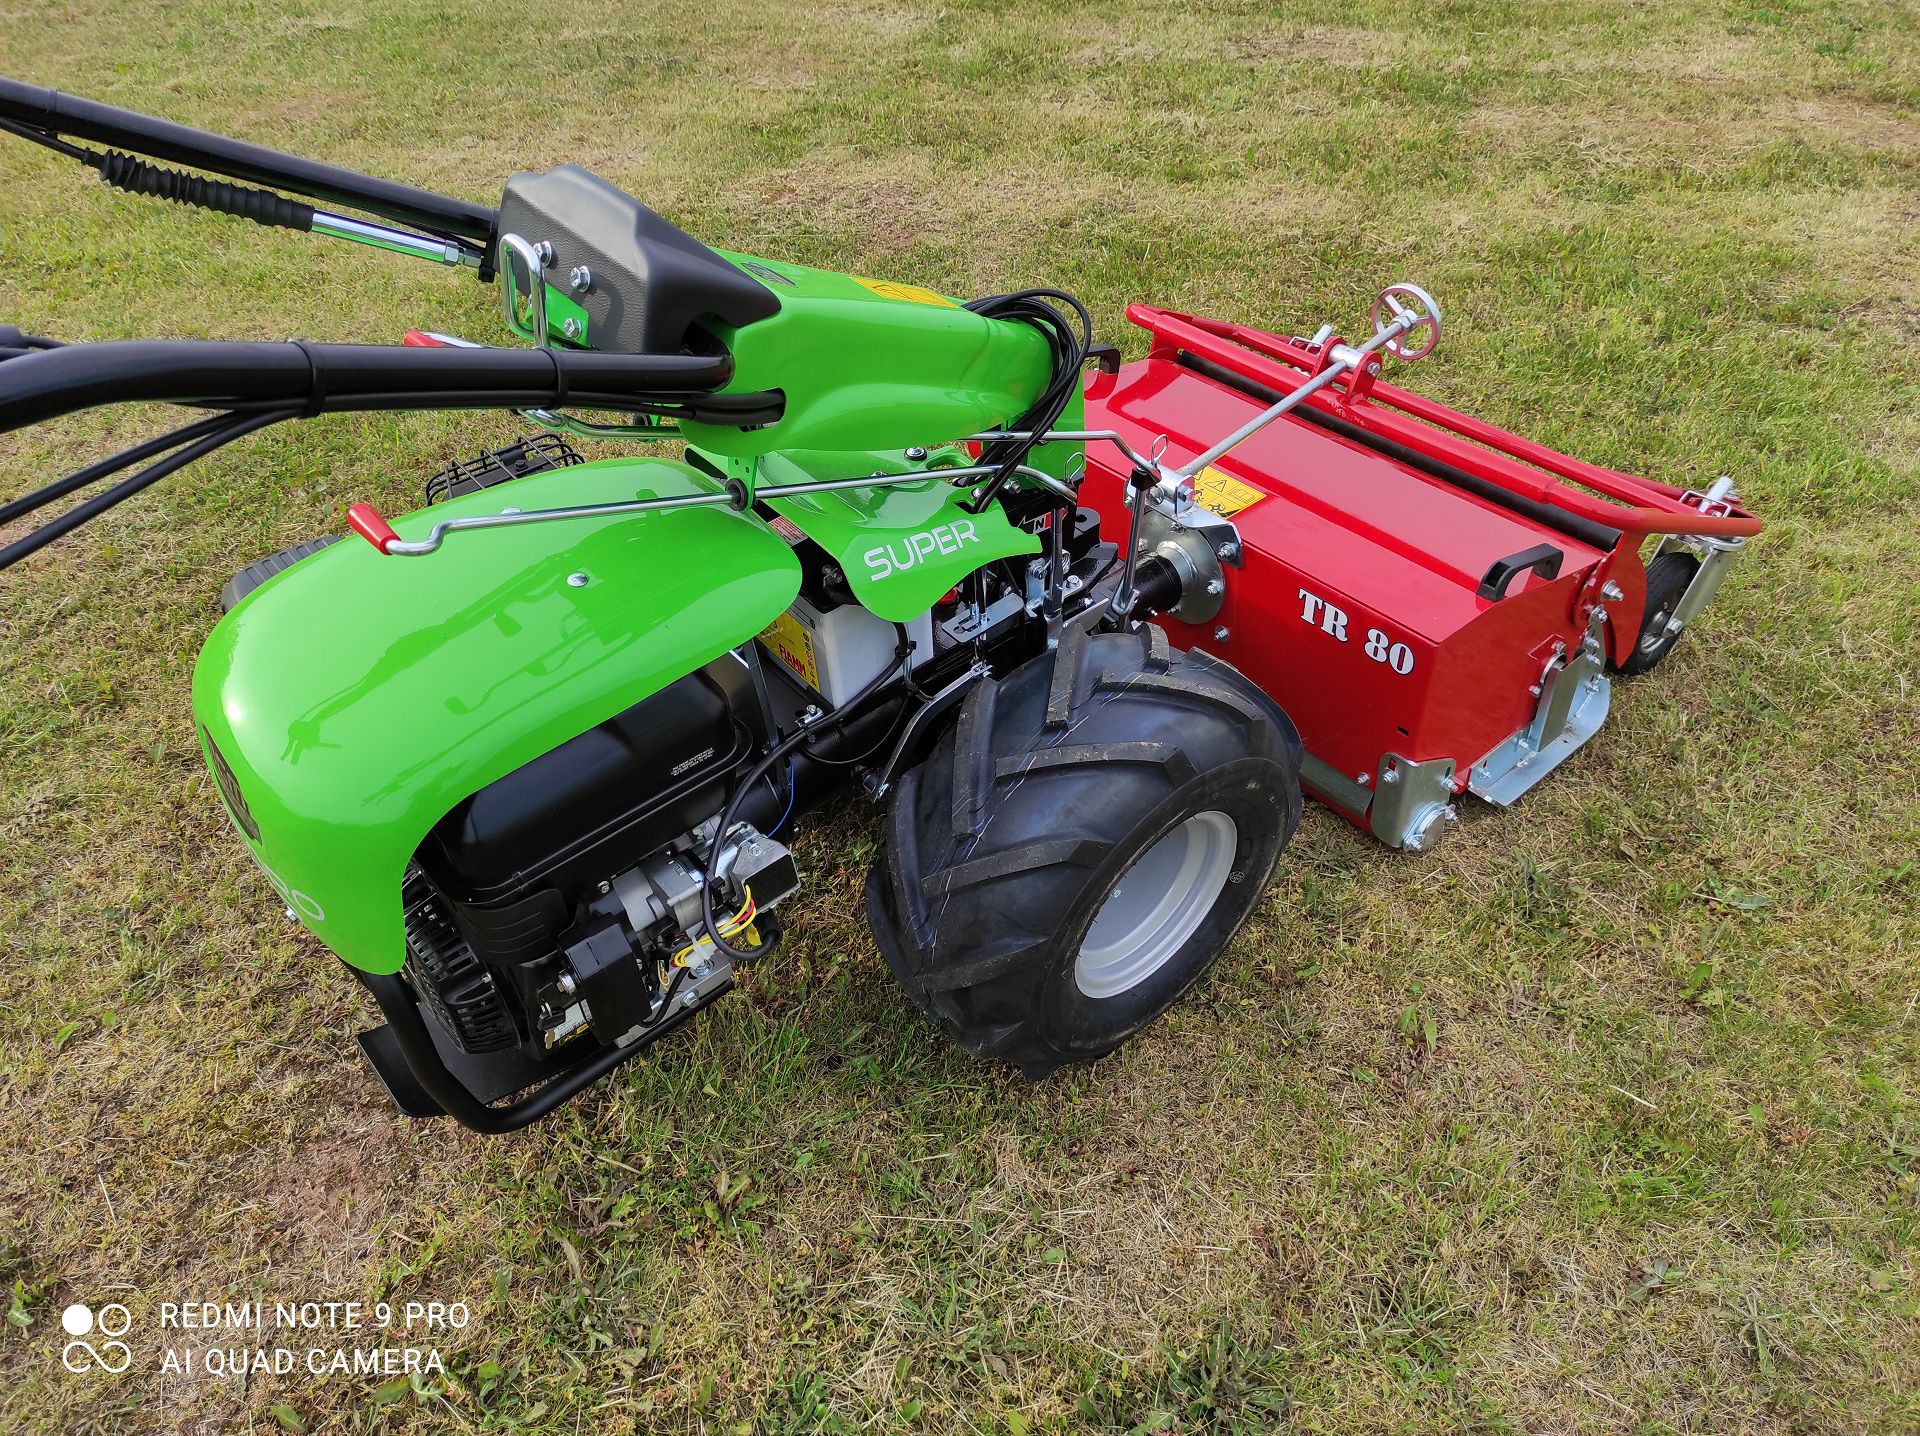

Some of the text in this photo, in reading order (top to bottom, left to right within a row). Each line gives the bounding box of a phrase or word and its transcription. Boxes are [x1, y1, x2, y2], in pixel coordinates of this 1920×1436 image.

[863, 519, 980, 581] SUPER
[778, 642, 807, 678] FIAMM
[1298, 587, 1415, 675] TR 80
